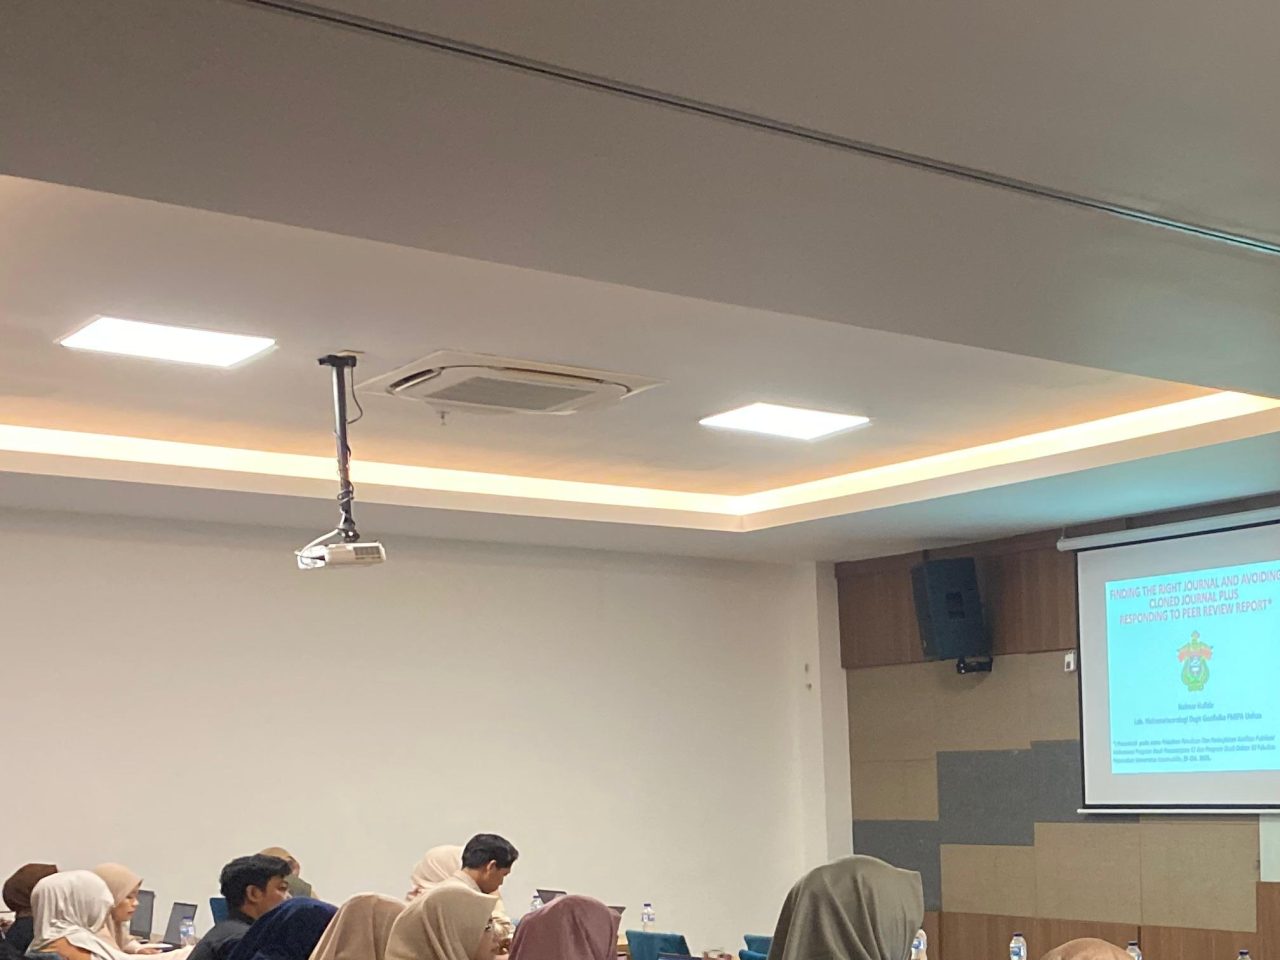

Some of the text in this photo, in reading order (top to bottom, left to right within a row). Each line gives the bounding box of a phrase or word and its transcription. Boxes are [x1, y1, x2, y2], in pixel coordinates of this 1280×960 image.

[1110, 587, 1141, 600] FINDING
[1143, 584, 1156, 596] THE
[1158, 582, 1181, 595] RIGHT
[1184, 578, 1219, 592] JOURNAL
[1221, 574, 1239, 587] AND
[1181, 591, 1217, 605] JOURNAL
[1219, 589, 1239, 601] PLUS
[1119, 610, 1168, 625] RESPONDING
[1170, 608, 1180, 620] TO
[1182, 606, 1200, 618] PEER
[1203, 602, 1233, 616] REVIEW
